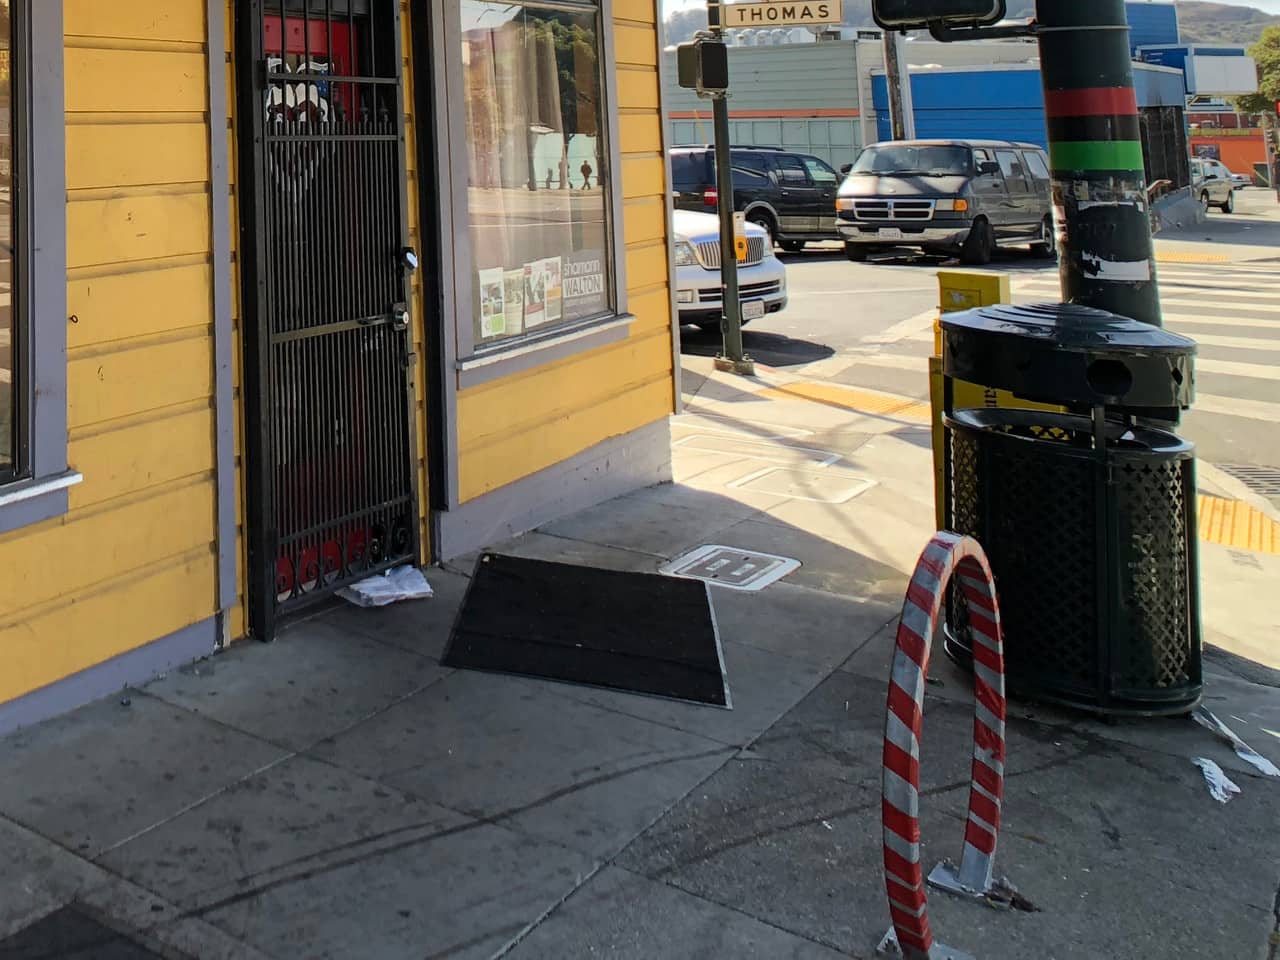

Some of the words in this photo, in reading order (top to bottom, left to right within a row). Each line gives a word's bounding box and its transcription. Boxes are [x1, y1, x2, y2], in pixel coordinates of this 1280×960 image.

[736, 4, 830, 22] THOMAS
[563, 256, 600, 277] shamann
[563, 275, 601, 298] WALTON
